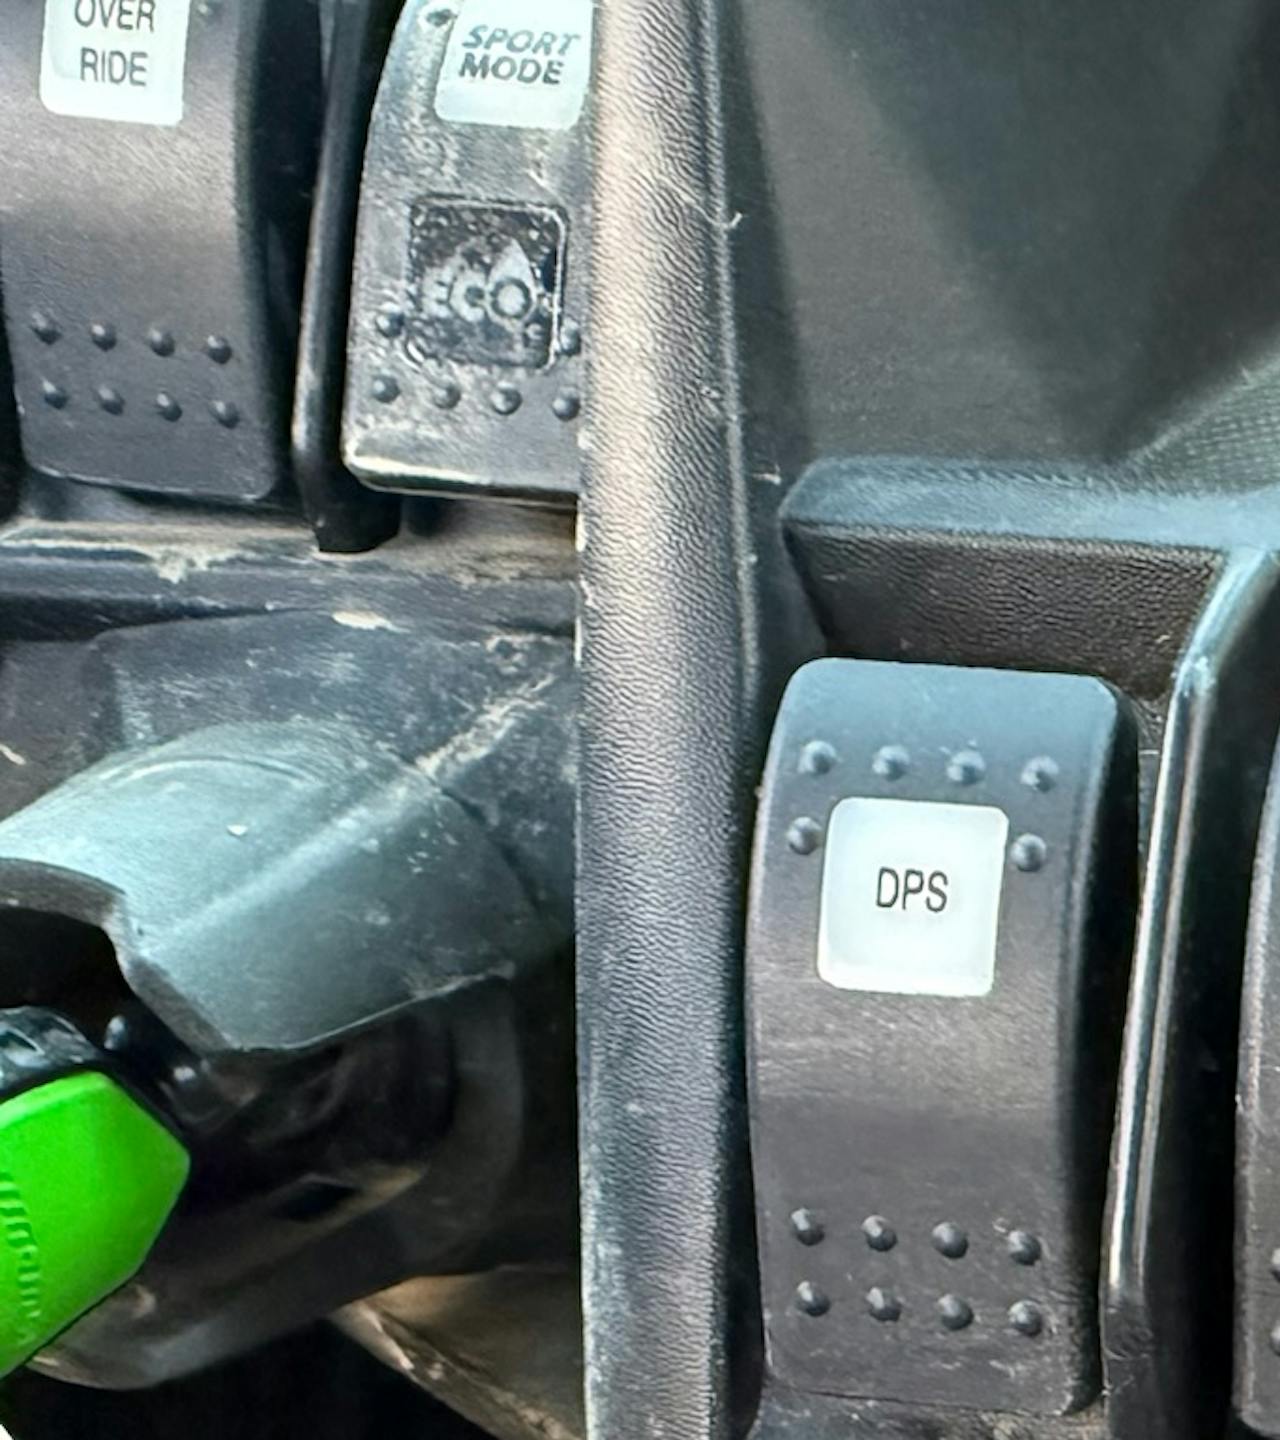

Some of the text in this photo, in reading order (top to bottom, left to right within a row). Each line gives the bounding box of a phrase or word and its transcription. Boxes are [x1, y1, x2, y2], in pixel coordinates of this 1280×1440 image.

[74, 0, 157, 33] OVER
[462, 24, 582, 56] SPORT
[79, 46, 149, 87] RIDE
[458, 52, 564, 85] MODE
[875, 867, 950, 914] DPS
